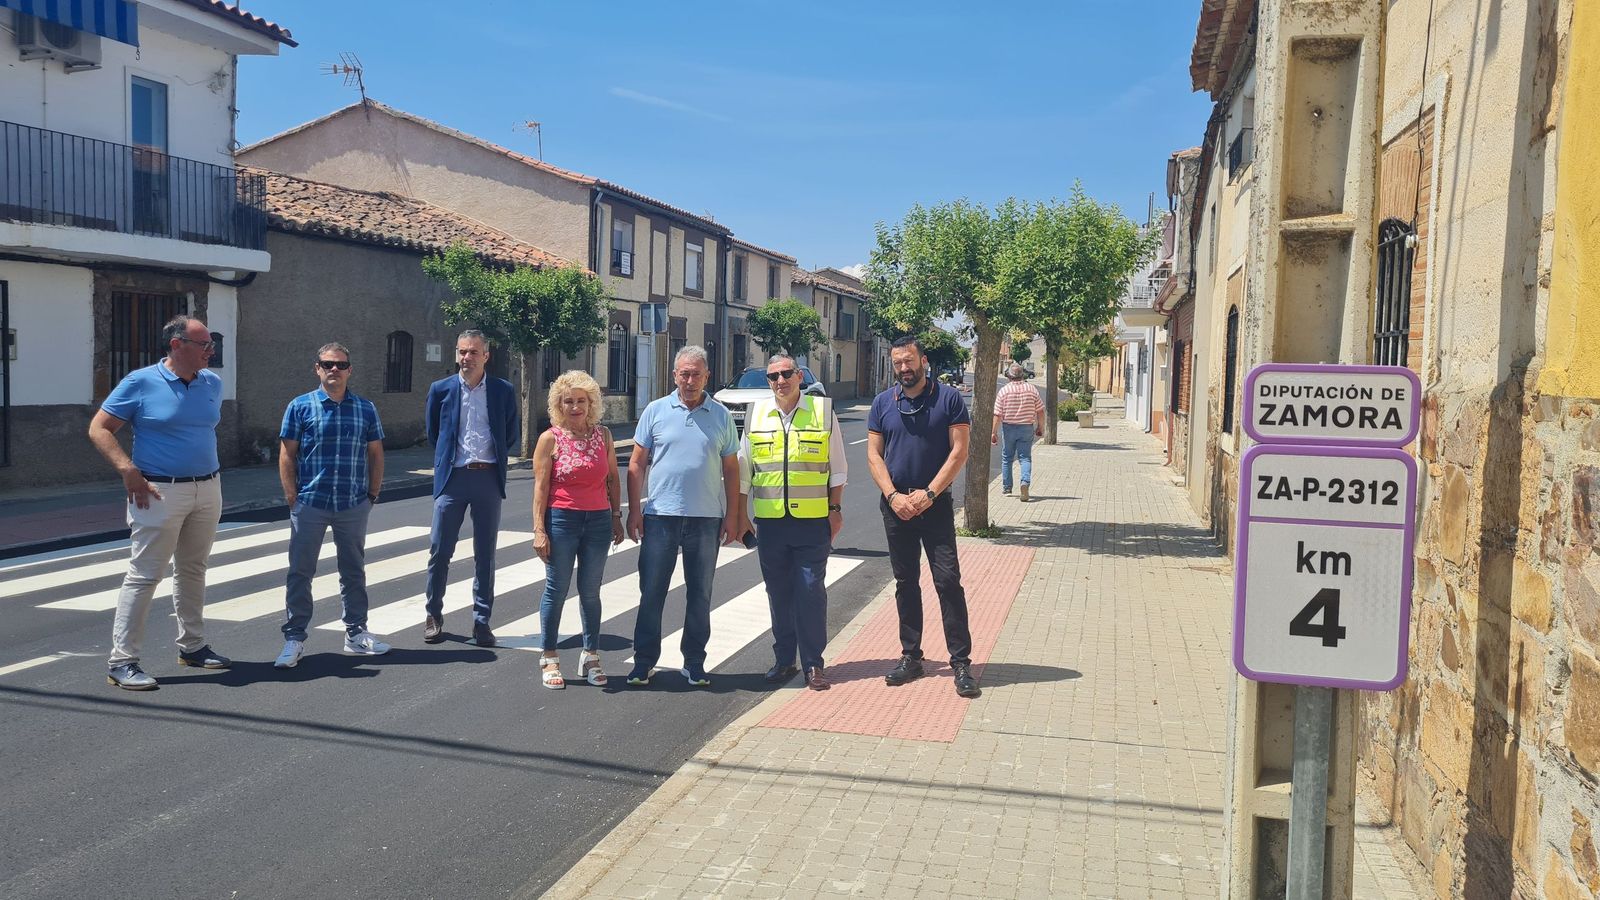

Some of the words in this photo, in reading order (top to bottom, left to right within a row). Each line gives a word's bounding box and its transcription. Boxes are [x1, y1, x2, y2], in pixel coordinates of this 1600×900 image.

[1260, 384, 1372, 400] DIPUTACIÓN
[1381, 388, 1405, 401] DE
[1259, 403, 1403, 430] ZAMORA
[1257, 475, 1399, 506] ZA-P-2312
[1296, 541, 1352, 576] km
[1289, 588, 1346, 648] 4
